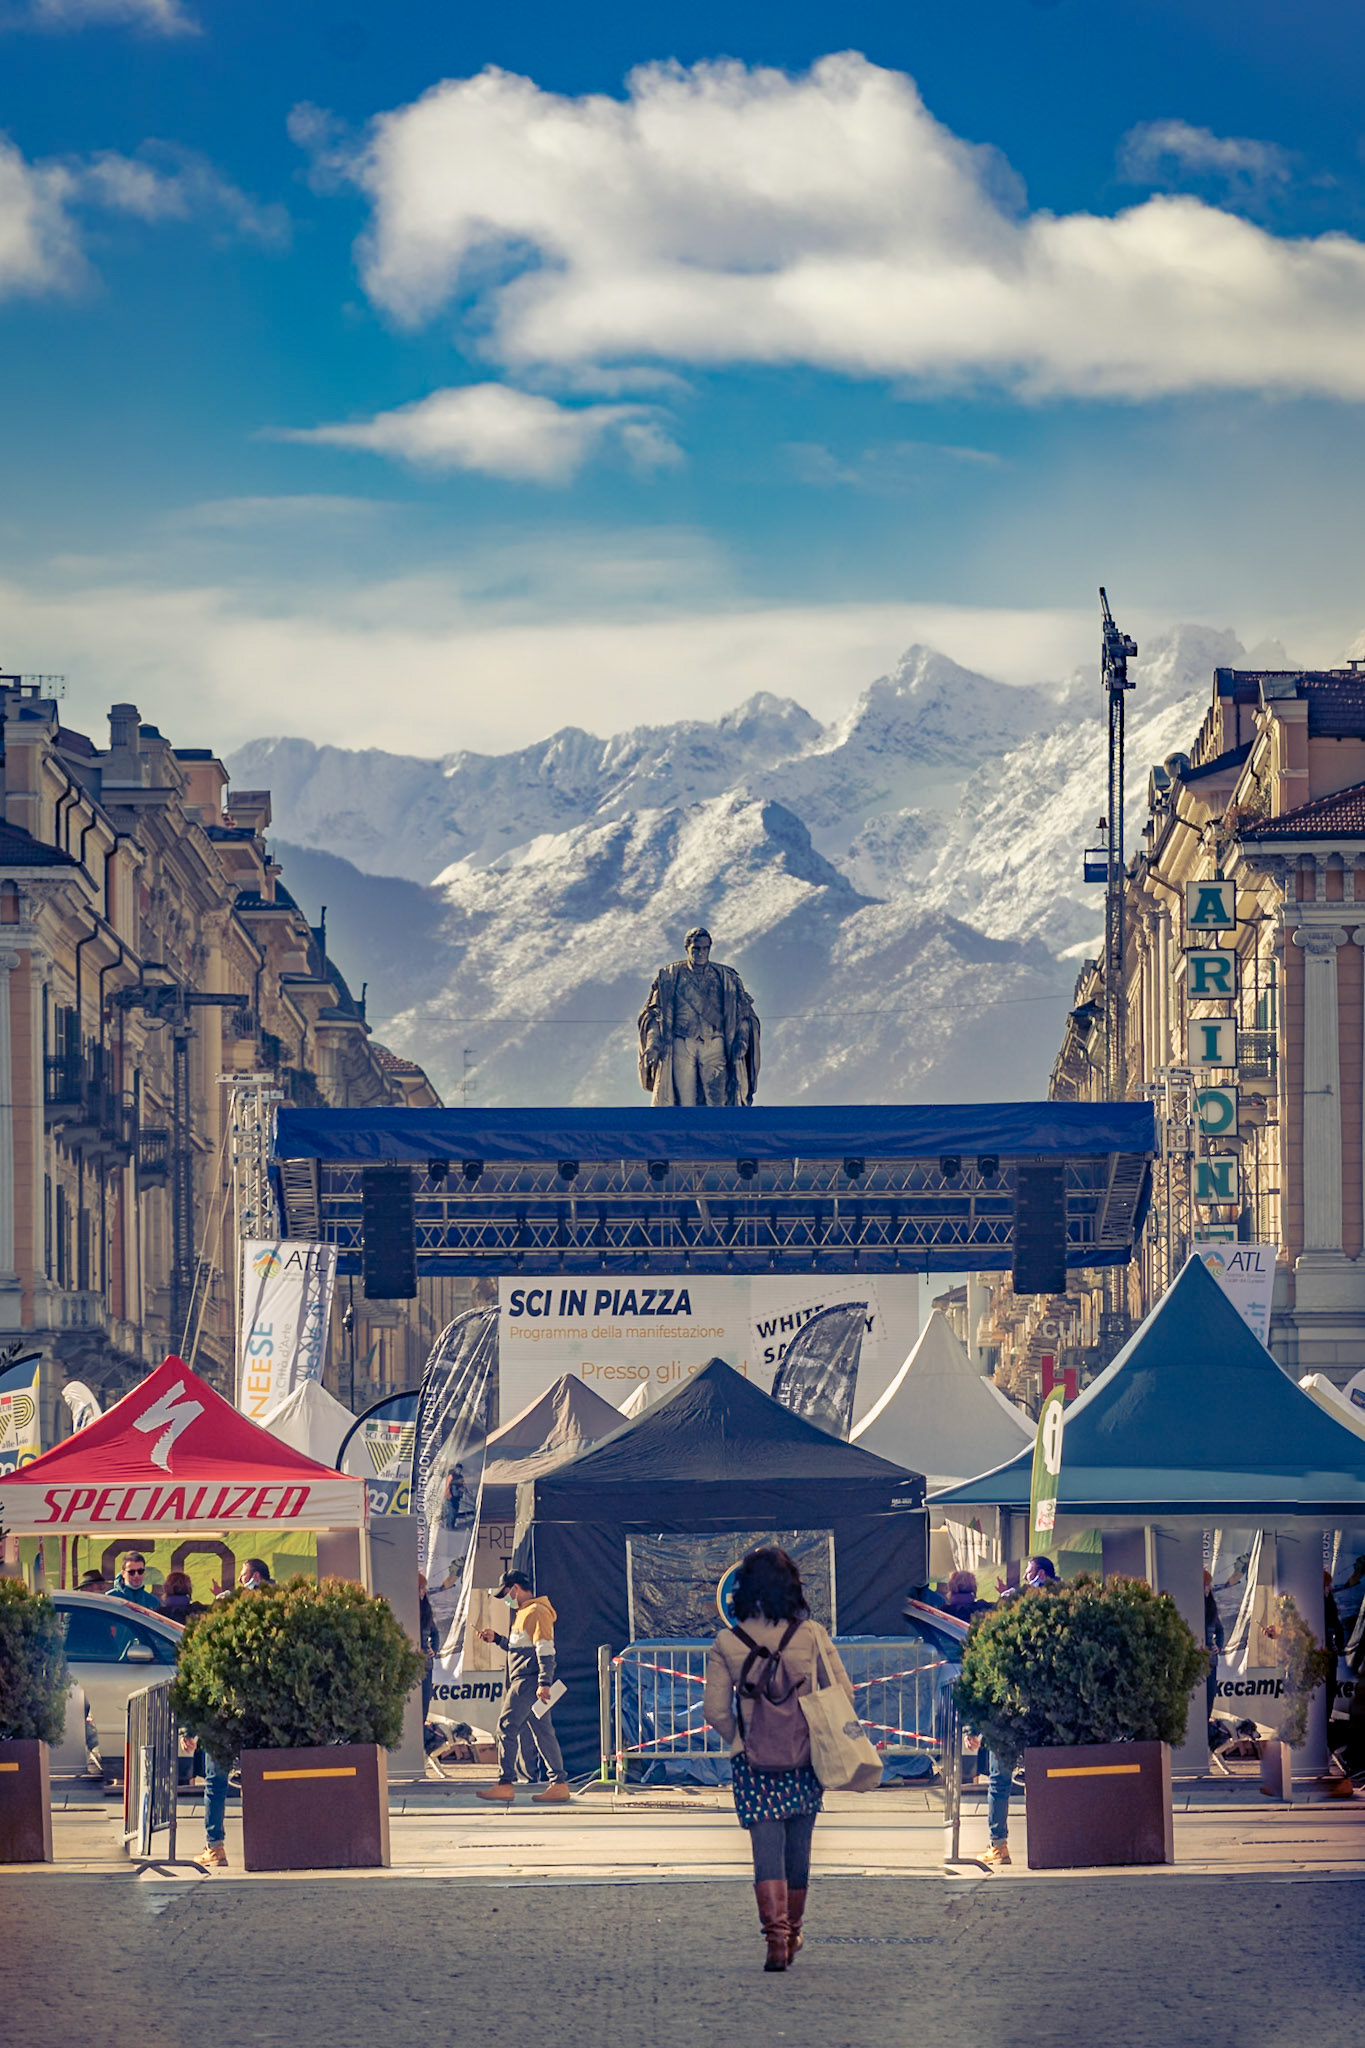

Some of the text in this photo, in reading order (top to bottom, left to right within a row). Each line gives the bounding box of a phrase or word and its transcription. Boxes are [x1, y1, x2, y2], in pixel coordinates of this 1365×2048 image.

[284, 1250, 327, 1272] ATL
[1226, 1251, 1266, 1272] ATL
[509, 1289, 692, 1317] SCI IN PIAZZA
[509, 1325, 725, 1342] Programma della manifestazione
[581, 1362, 650, 1380] Presso
[656, 1361, 681, 1384] gli
[420, 1429, 432, 1446] IN
[416, 1446, 431, 1513] OUTDOOR
[34, 1486, 311, 1524] SPECIALIZED
